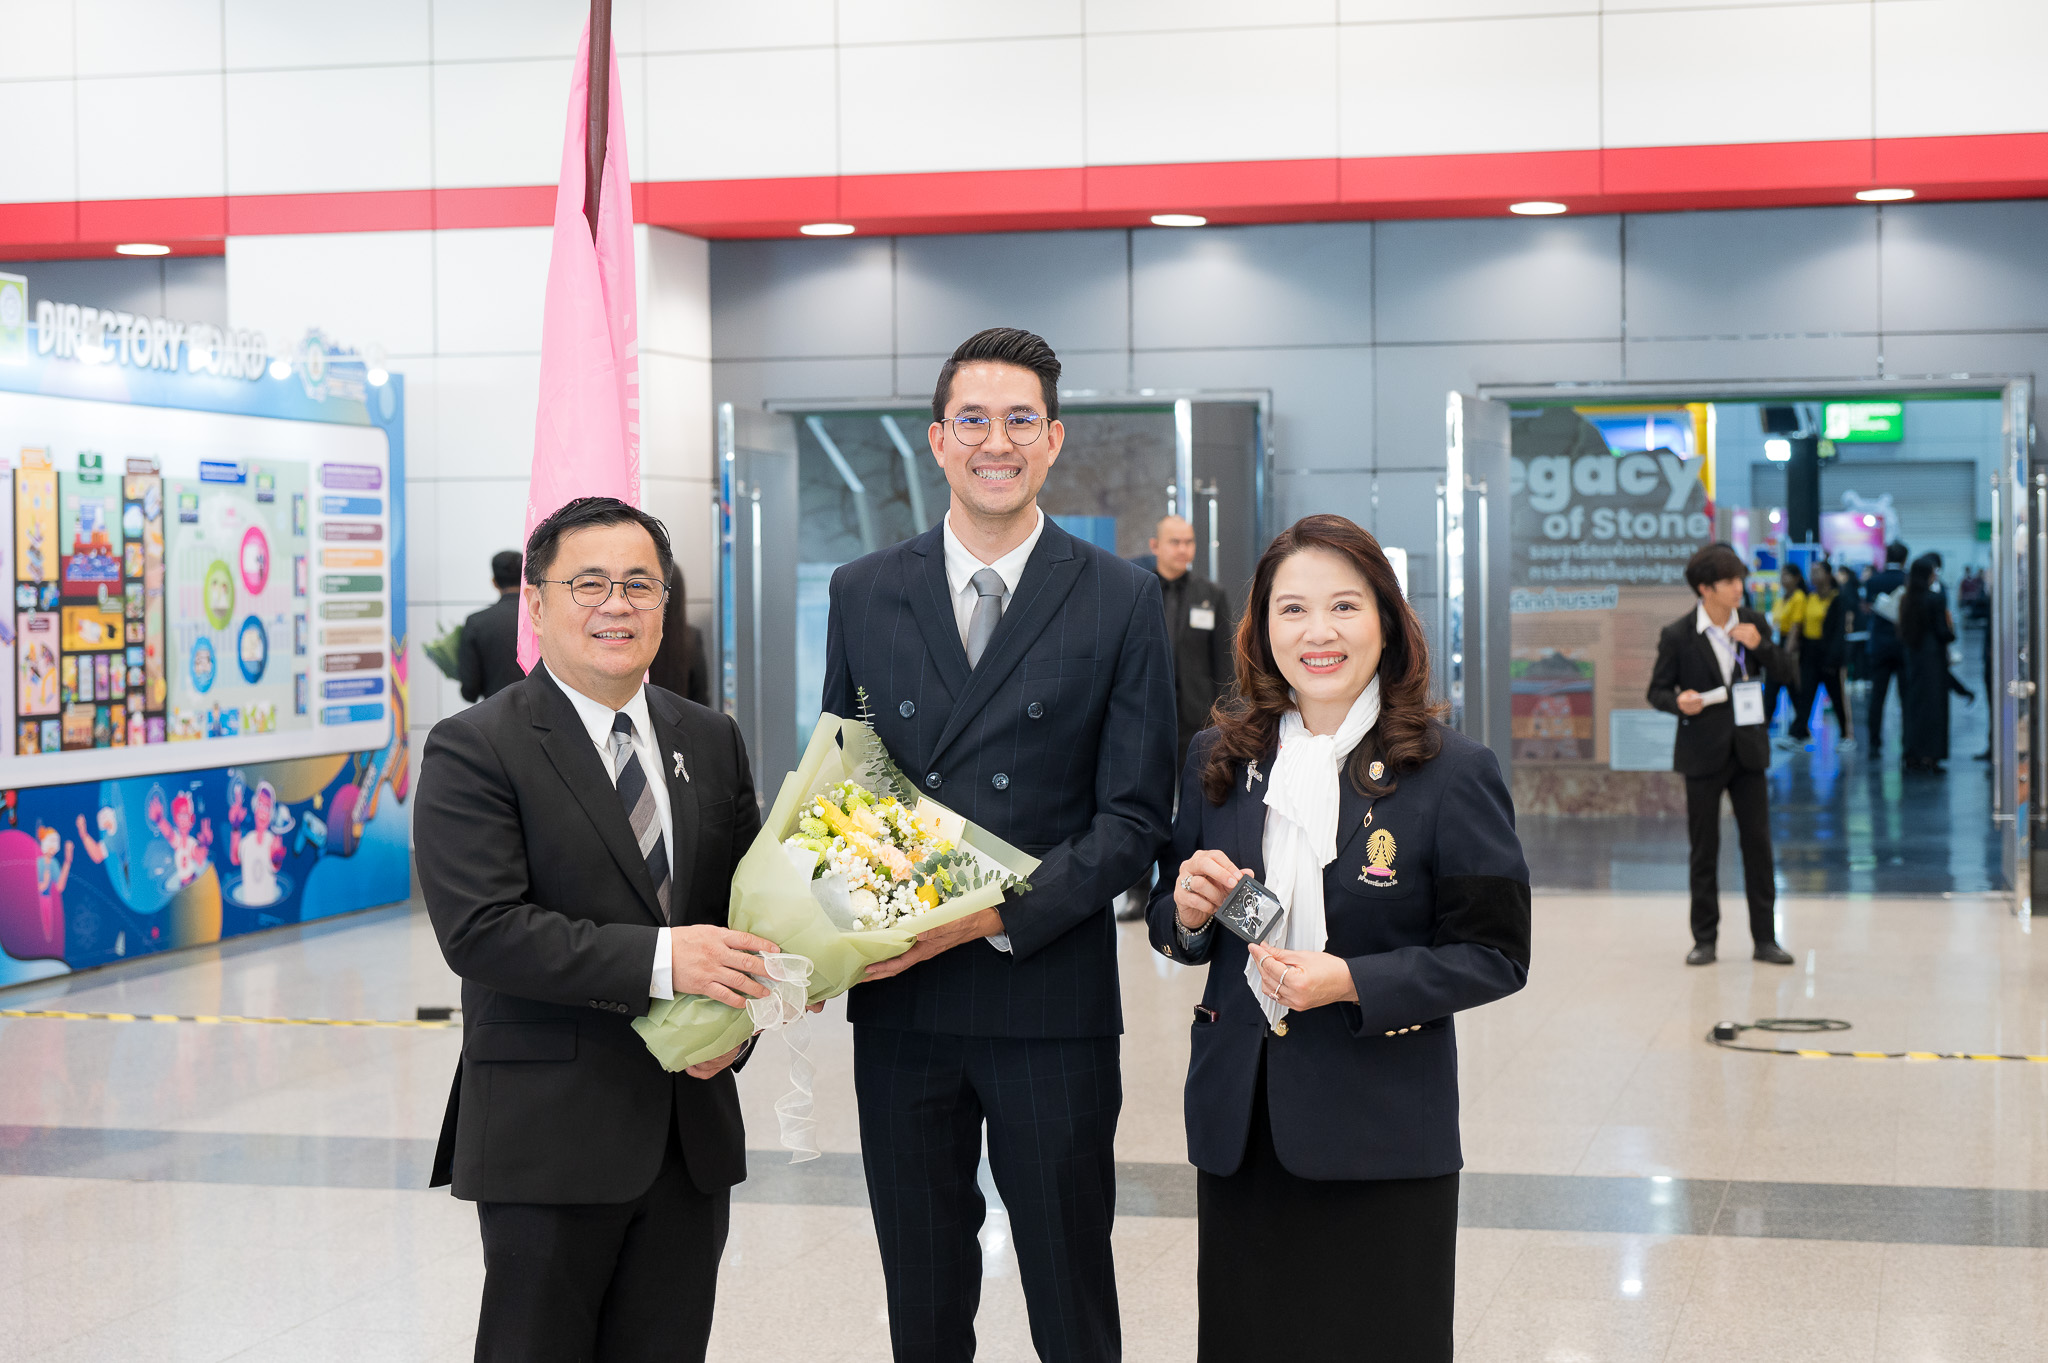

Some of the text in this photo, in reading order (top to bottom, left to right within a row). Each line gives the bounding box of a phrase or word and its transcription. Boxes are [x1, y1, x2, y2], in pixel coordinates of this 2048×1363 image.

[36, 299, 185, 372] DIRECTORY
[1543, 505, 1710, 540] of Stone
